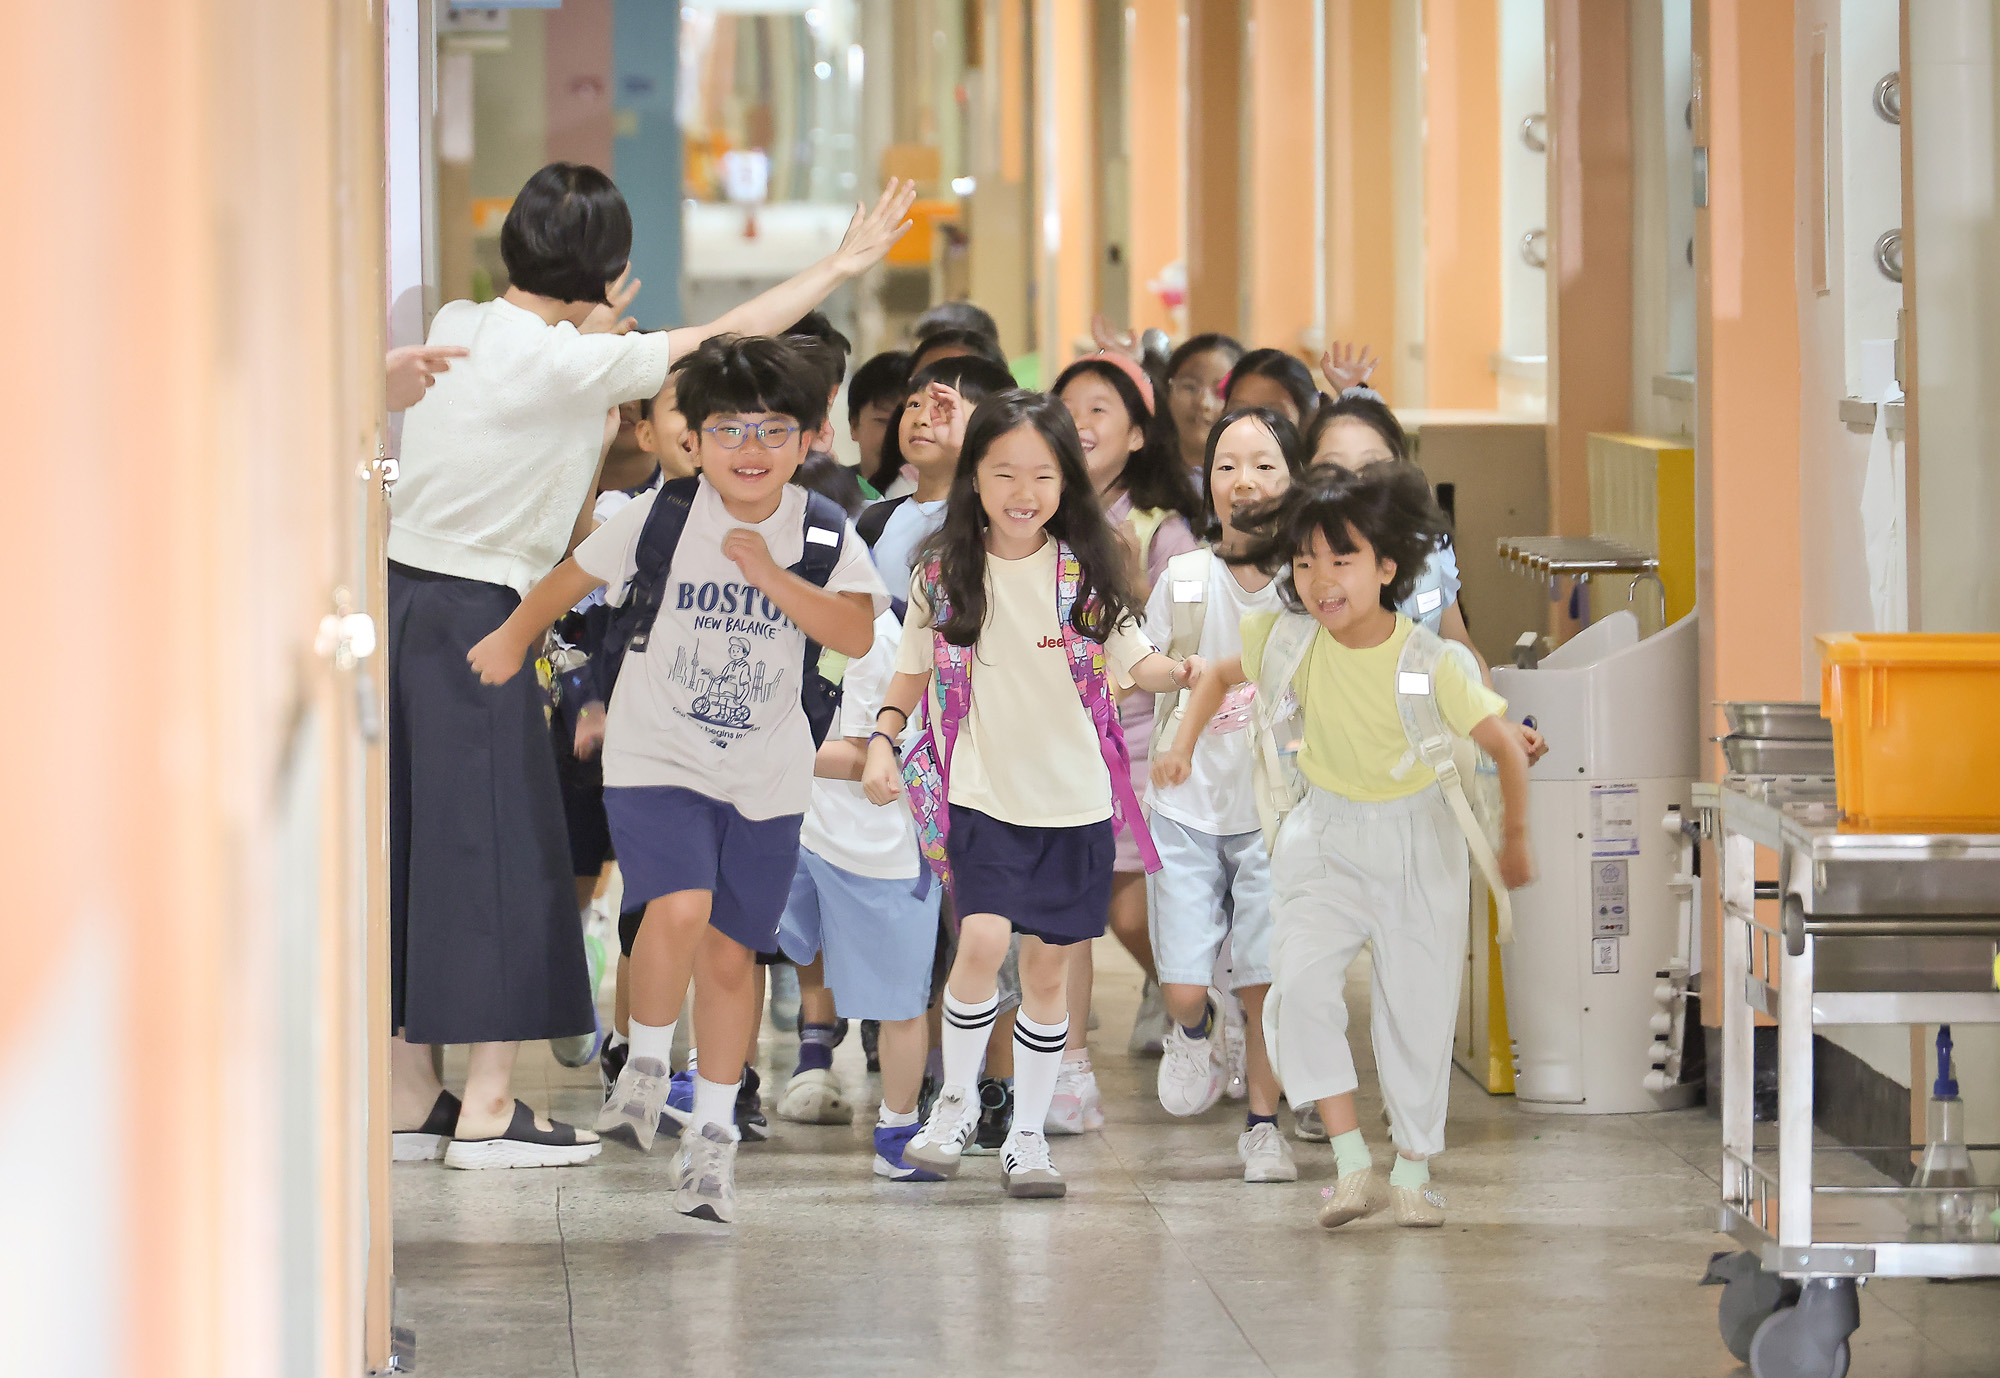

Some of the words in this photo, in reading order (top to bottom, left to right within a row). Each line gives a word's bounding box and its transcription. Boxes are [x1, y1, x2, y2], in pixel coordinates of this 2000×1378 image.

[694, 615, 722, 630] NEW
[725, 616, 776, 640] BALANCE
[704, 725, 734, 739] begins
[735, 731, 743, 740] in
